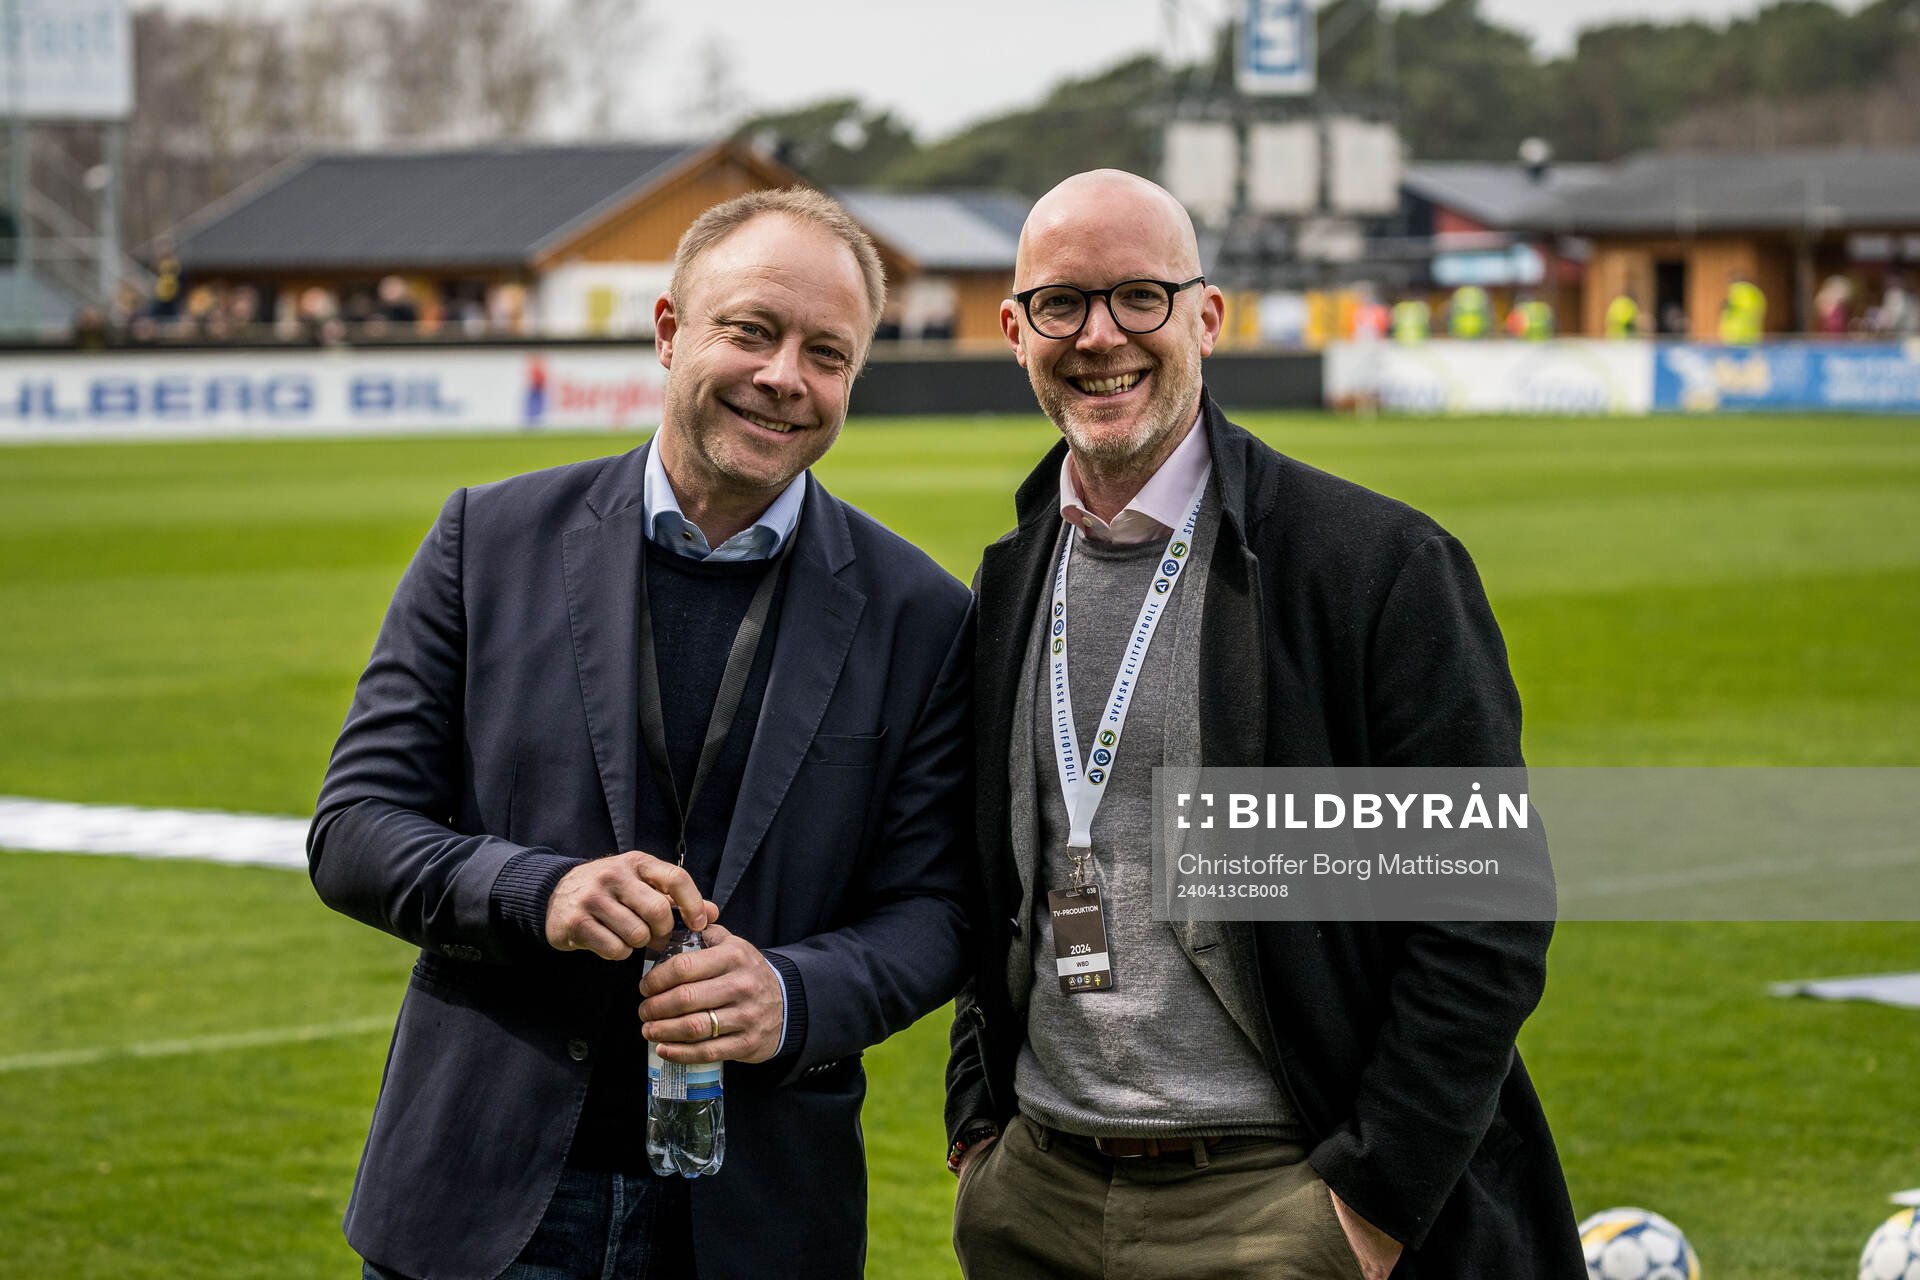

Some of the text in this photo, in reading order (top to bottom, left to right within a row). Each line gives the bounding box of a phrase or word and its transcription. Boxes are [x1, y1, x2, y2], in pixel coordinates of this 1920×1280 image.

[1110, 603, 1158, 722] SVENSK ELITFOTBOLL
[1055, 663, 1077, 783] SVENSK ELITFOTBOLL
[1053, 905, 1099, 917] TV-PRODUKTION
[1070, 943, 1092, 955] 2024
